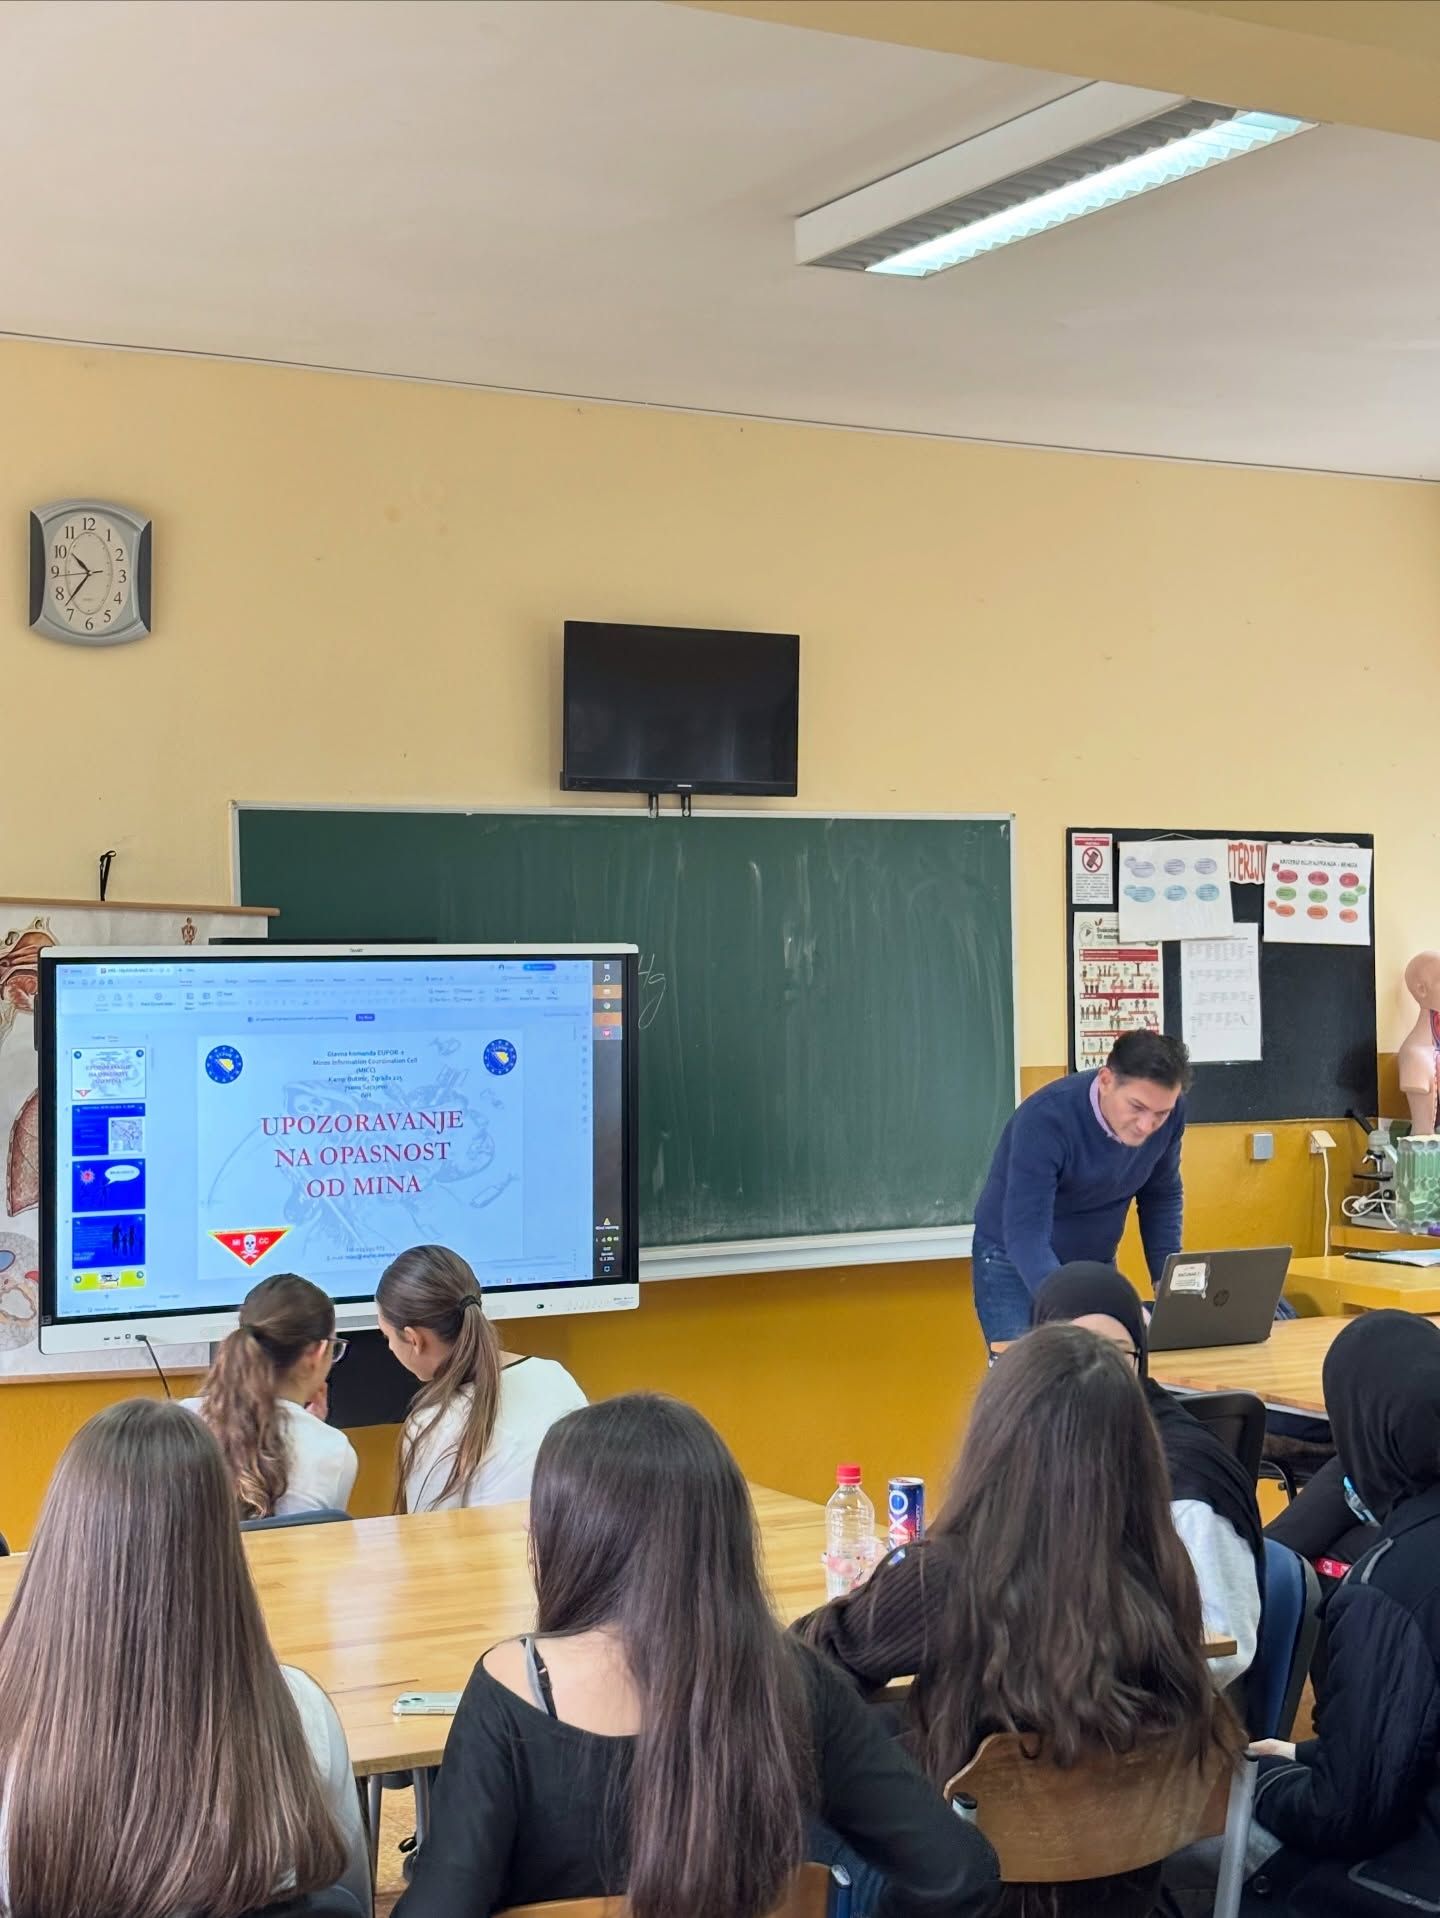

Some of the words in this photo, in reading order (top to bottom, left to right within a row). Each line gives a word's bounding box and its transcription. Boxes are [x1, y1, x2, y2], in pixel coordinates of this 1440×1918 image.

[82, 517, 96, 531] 12
[65, 526, 75, 539] 11
[106, 528, 111, 542] 1
[54, 545, 67, 559] 10
[115, 548, 124, 562] 2
[51, 565, 60, 578] 9
[118, 569, 127, 583] 3
[55, 587, 64, 601] 8
[113, 591, 122, 604] 4
[66, 608, 75, 621] 7
[103, 609, 112, 623] 5
[85, 617, 94, 630] 6
[261, 1110, 464, 1136] UPOZORAVANJE
[275, 1148, 312, 1168] NA
[319, 1141, 451, 1166] OPASNOST
[306, 1178, 345, 1198] OD
[353, 1174, 422, 1196] MINA
